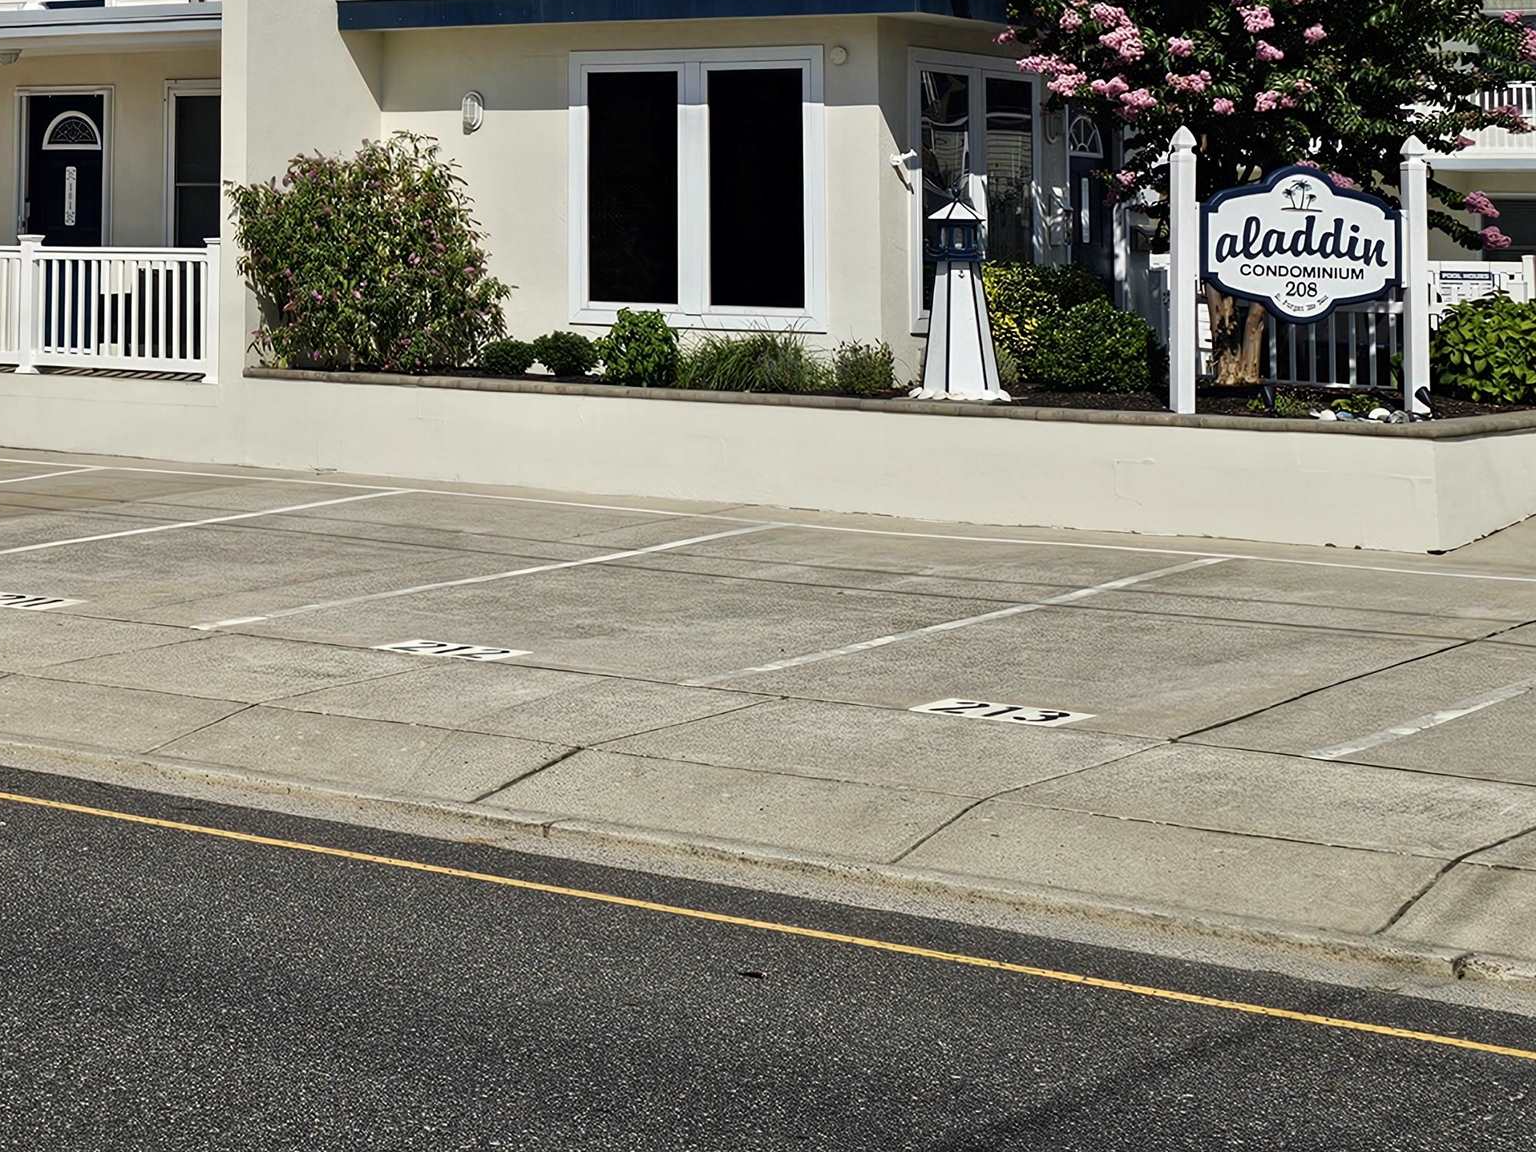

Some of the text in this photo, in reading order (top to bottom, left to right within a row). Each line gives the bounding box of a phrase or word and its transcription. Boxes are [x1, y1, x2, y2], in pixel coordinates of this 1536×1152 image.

[1215, 215, 1389, 267] aladdin
[1240, 263, 1365, 280] CONDOMINIUM
[1285, 280, 1318, 298] 208
[390, 641, 511, 659] 212
[927, 701, 1071, 722] 213
